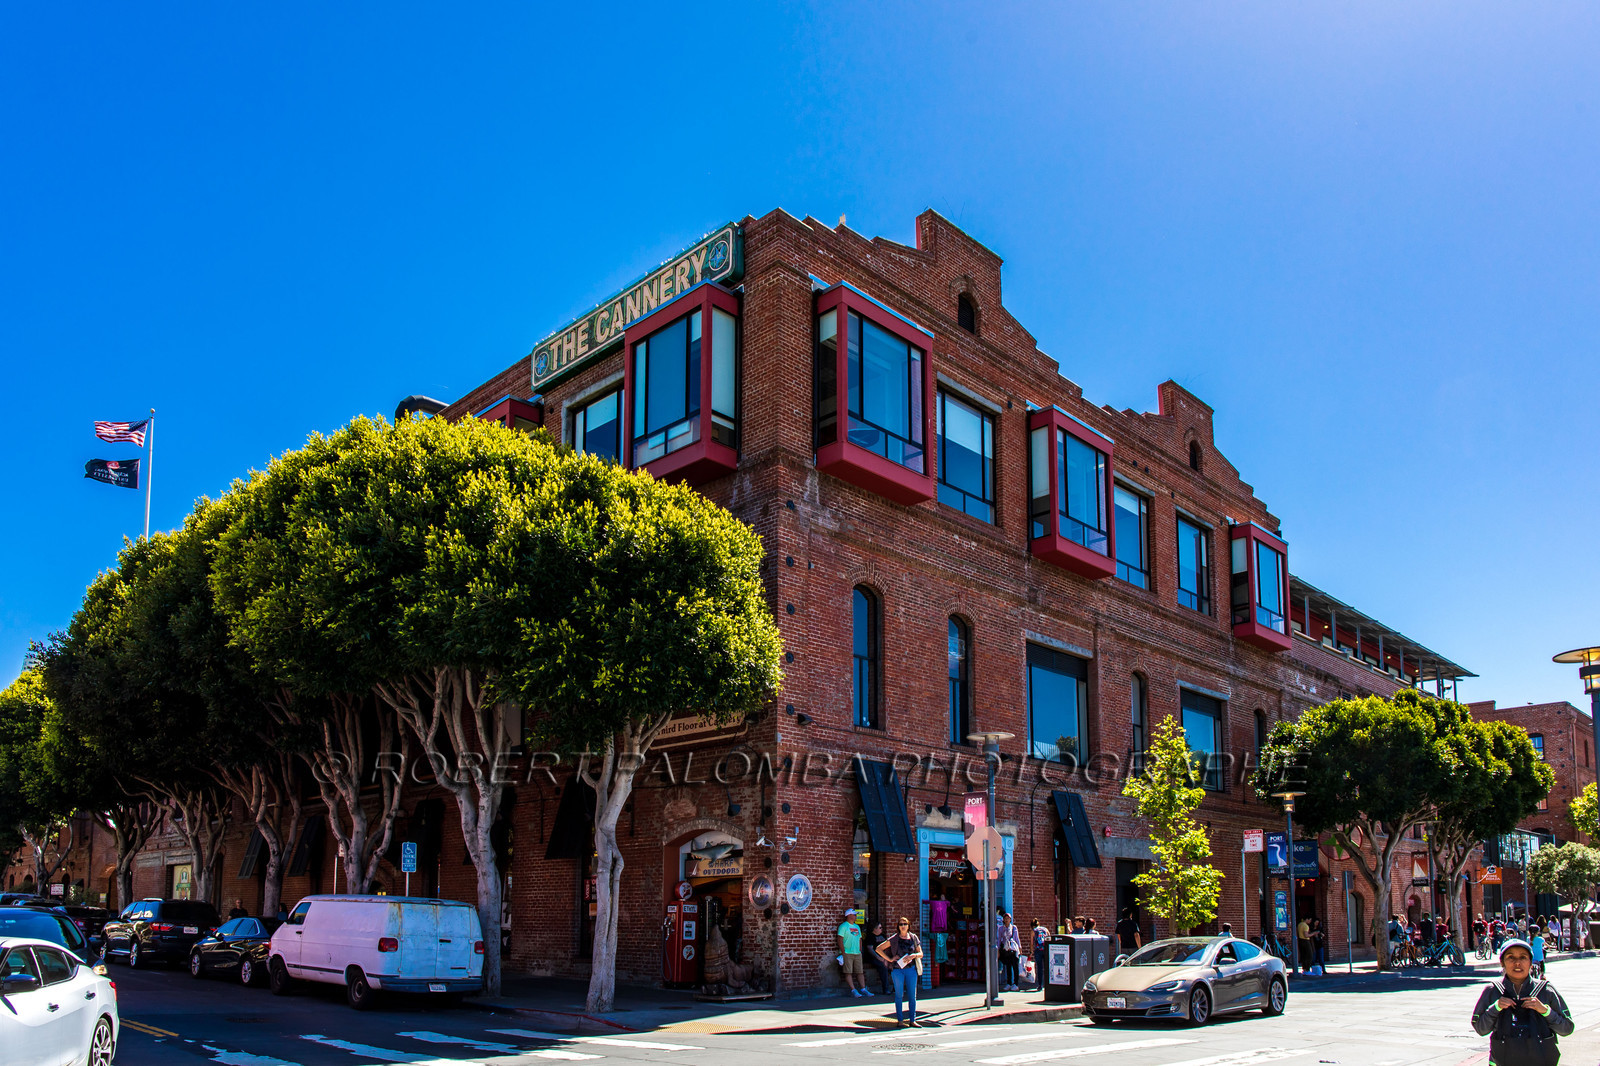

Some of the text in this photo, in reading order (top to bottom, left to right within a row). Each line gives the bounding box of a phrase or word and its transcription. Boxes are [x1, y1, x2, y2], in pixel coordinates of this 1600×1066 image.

[549, 246, 708, 371] THE CANNERY
[657, 715, 741, 736] hird Floor at Caery
[703, 867, 740, 875] OUTDOORS
[708, 859, 734, 868] WHARF
